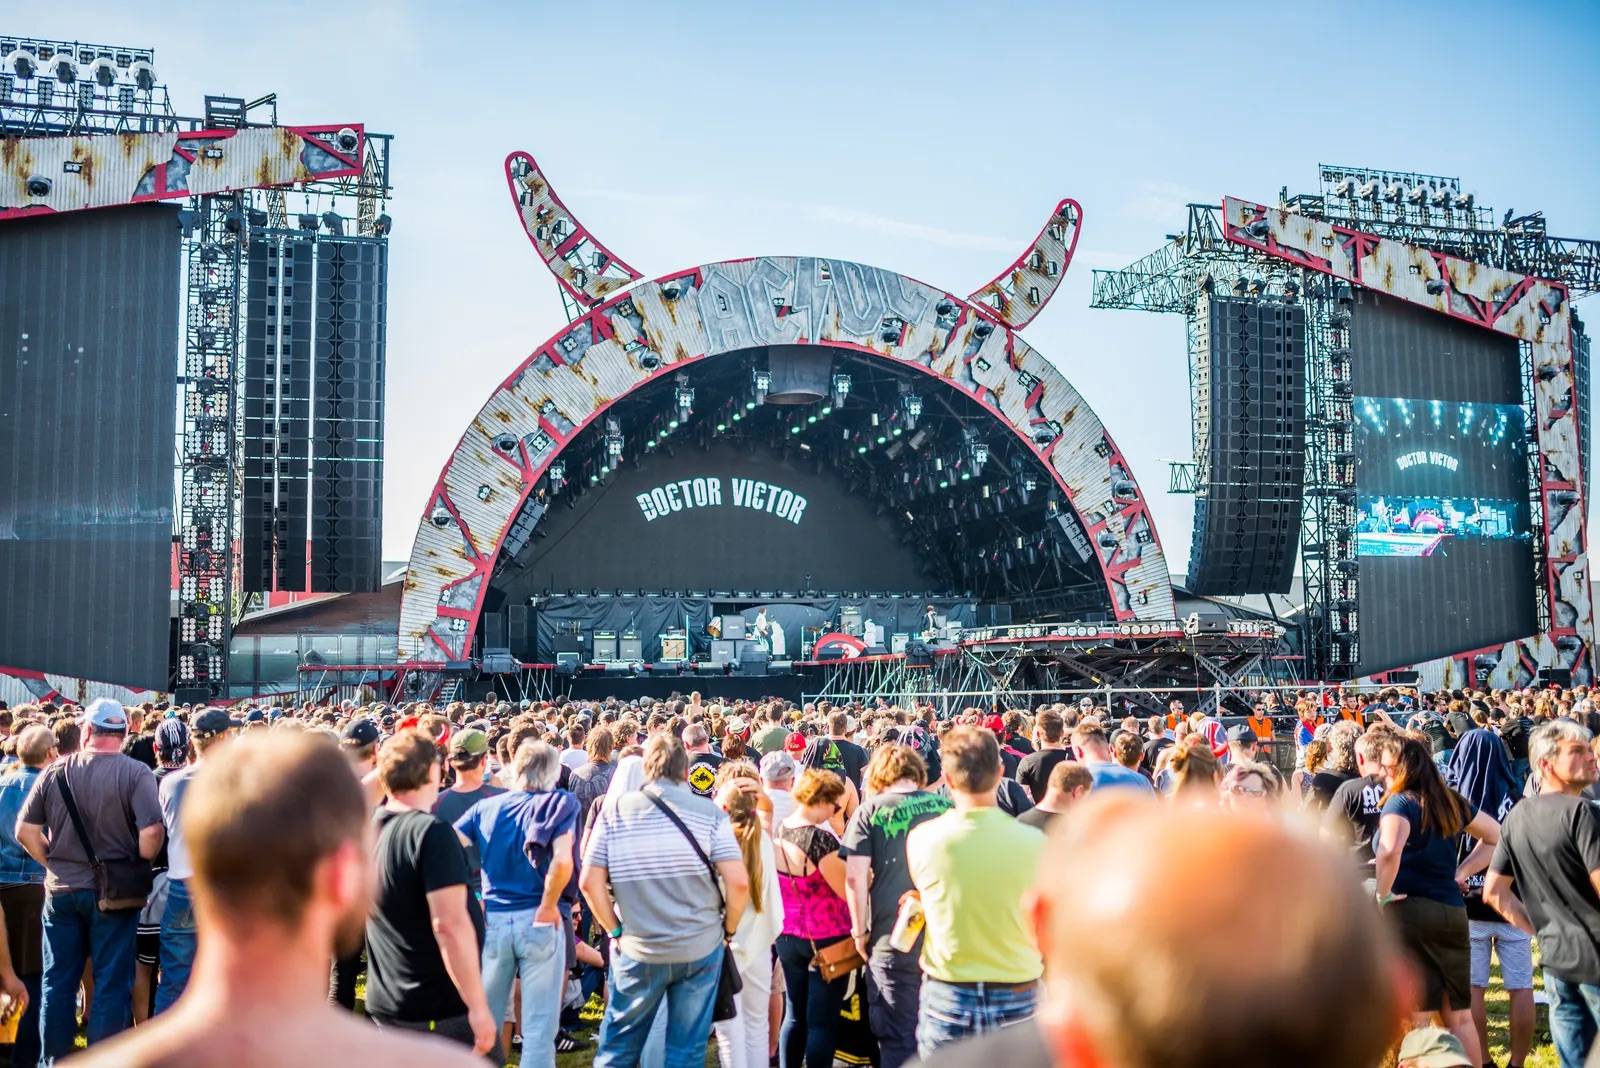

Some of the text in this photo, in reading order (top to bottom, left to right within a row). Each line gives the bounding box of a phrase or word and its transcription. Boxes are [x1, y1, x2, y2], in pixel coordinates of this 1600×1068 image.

[1396, 451, 1458, 471] DOCTOR VICTOR
[636, 477, 807, 525] DOCTOR VICTOR
